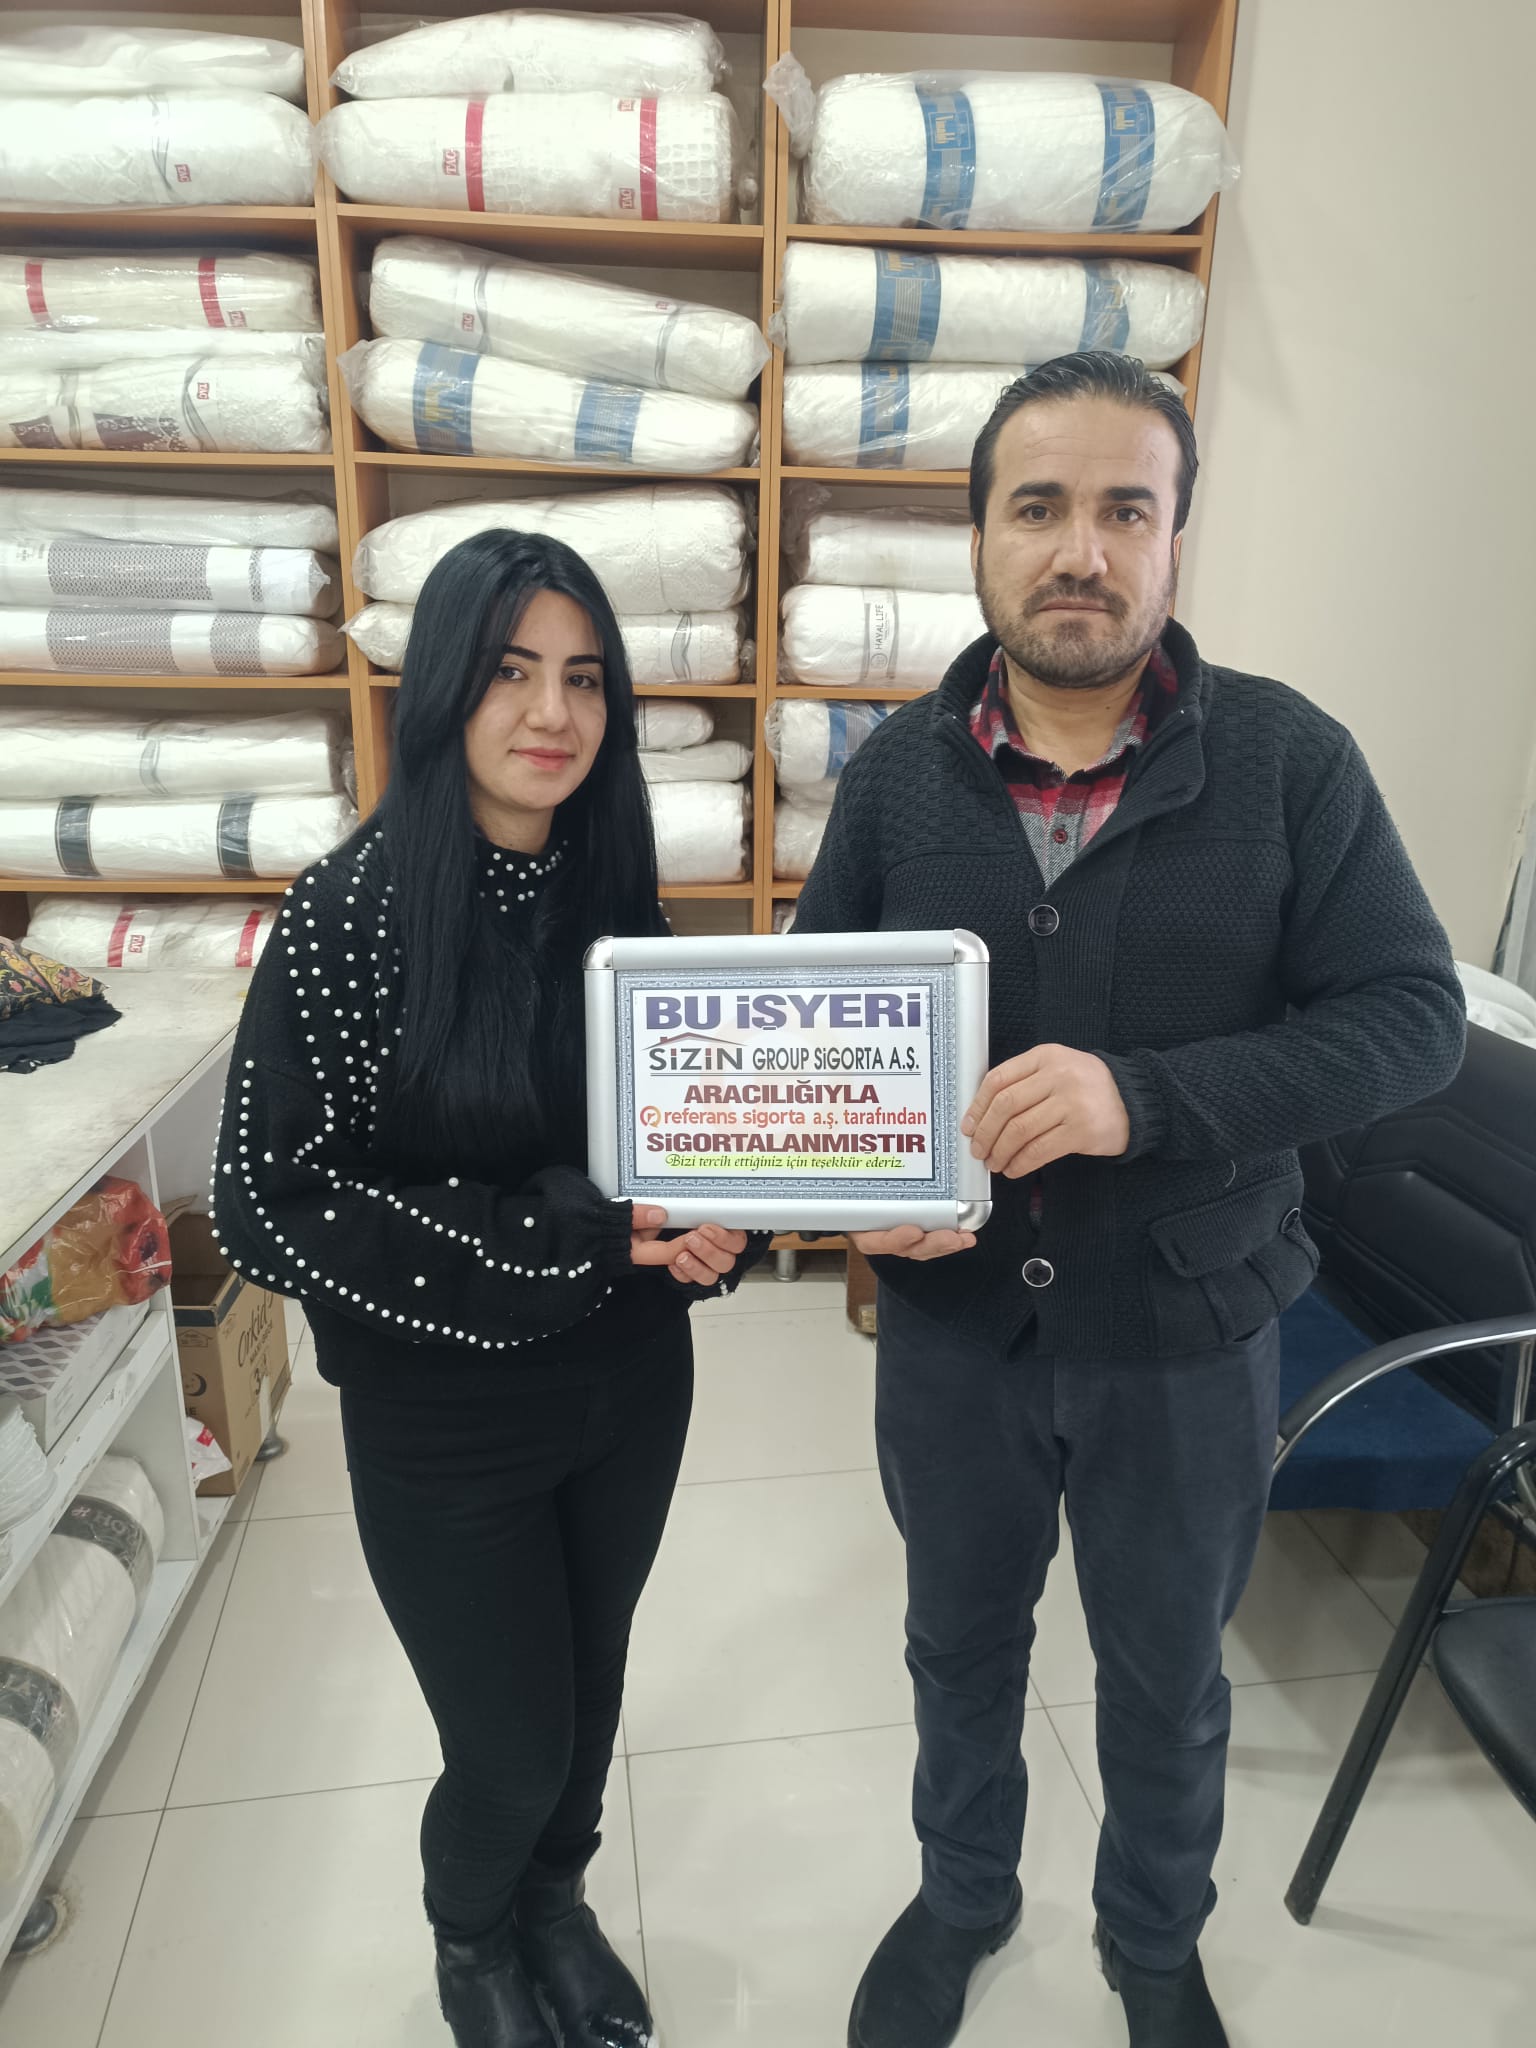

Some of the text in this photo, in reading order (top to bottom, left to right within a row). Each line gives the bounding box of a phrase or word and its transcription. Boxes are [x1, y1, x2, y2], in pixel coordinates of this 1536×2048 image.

[646, 995, 721, 1030] BU
[753, 1047, 809, 1071] GROUP
[684, 1079, 880, 1105] ARACILIĞIYLA
[664, 1107, 737, 1124] referans
[743, 1109, 806, 1129] sigorta
[844, 1106, 927, 1125] tarafından
[665, 1153, 906, 1172] Bizi tercih ettiğiniz için teşekkür ederiz.
